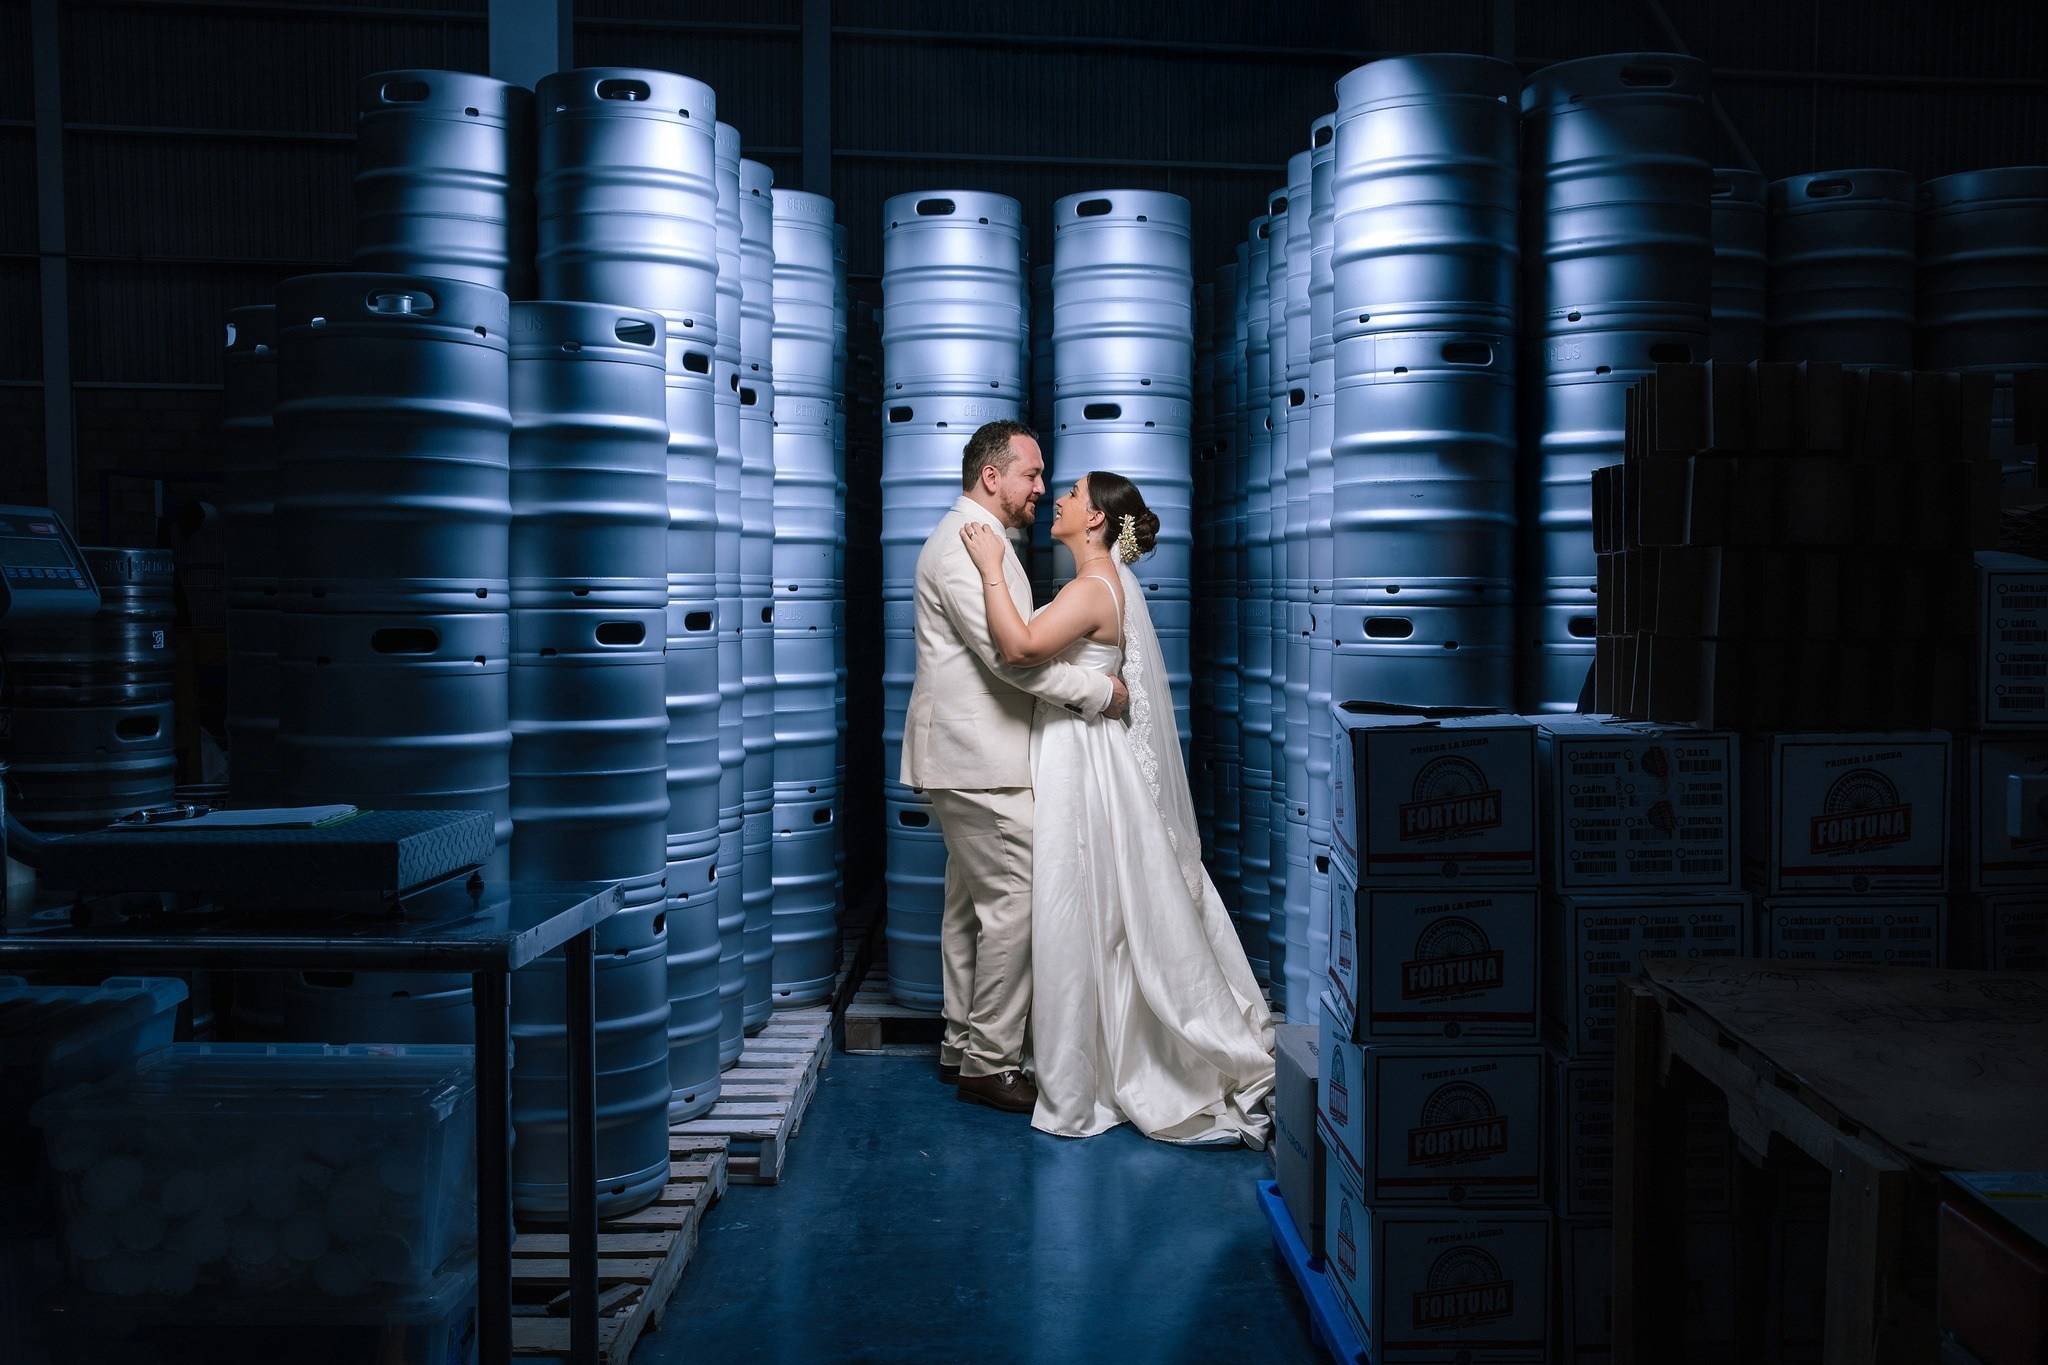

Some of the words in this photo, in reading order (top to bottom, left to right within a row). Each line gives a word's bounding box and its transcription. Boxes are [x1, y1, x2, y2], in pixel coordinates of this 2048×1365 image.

[1449, 741, 1460, 750] LA
[1686, 749, 1710, 757] SAKE
[1862, 755, 1873, 763] LA
[1406, 797, 1497, 833] FORTUNA
[1816, 810, 1906, 845] FORTUNA
[1452, 902, 1463, 911] LA
[1700, 914, 1723, 923] SAKE
[1897, 915, 1920, 924] SAKE
[1408, 957, 1498, 992] FORTUNA
[1458, 1066, 1469, 1075] LA
[1414, 1123, 1503, 1159] FORTUNA
[1419, 1287, 1508, 1321] FORTUNA
